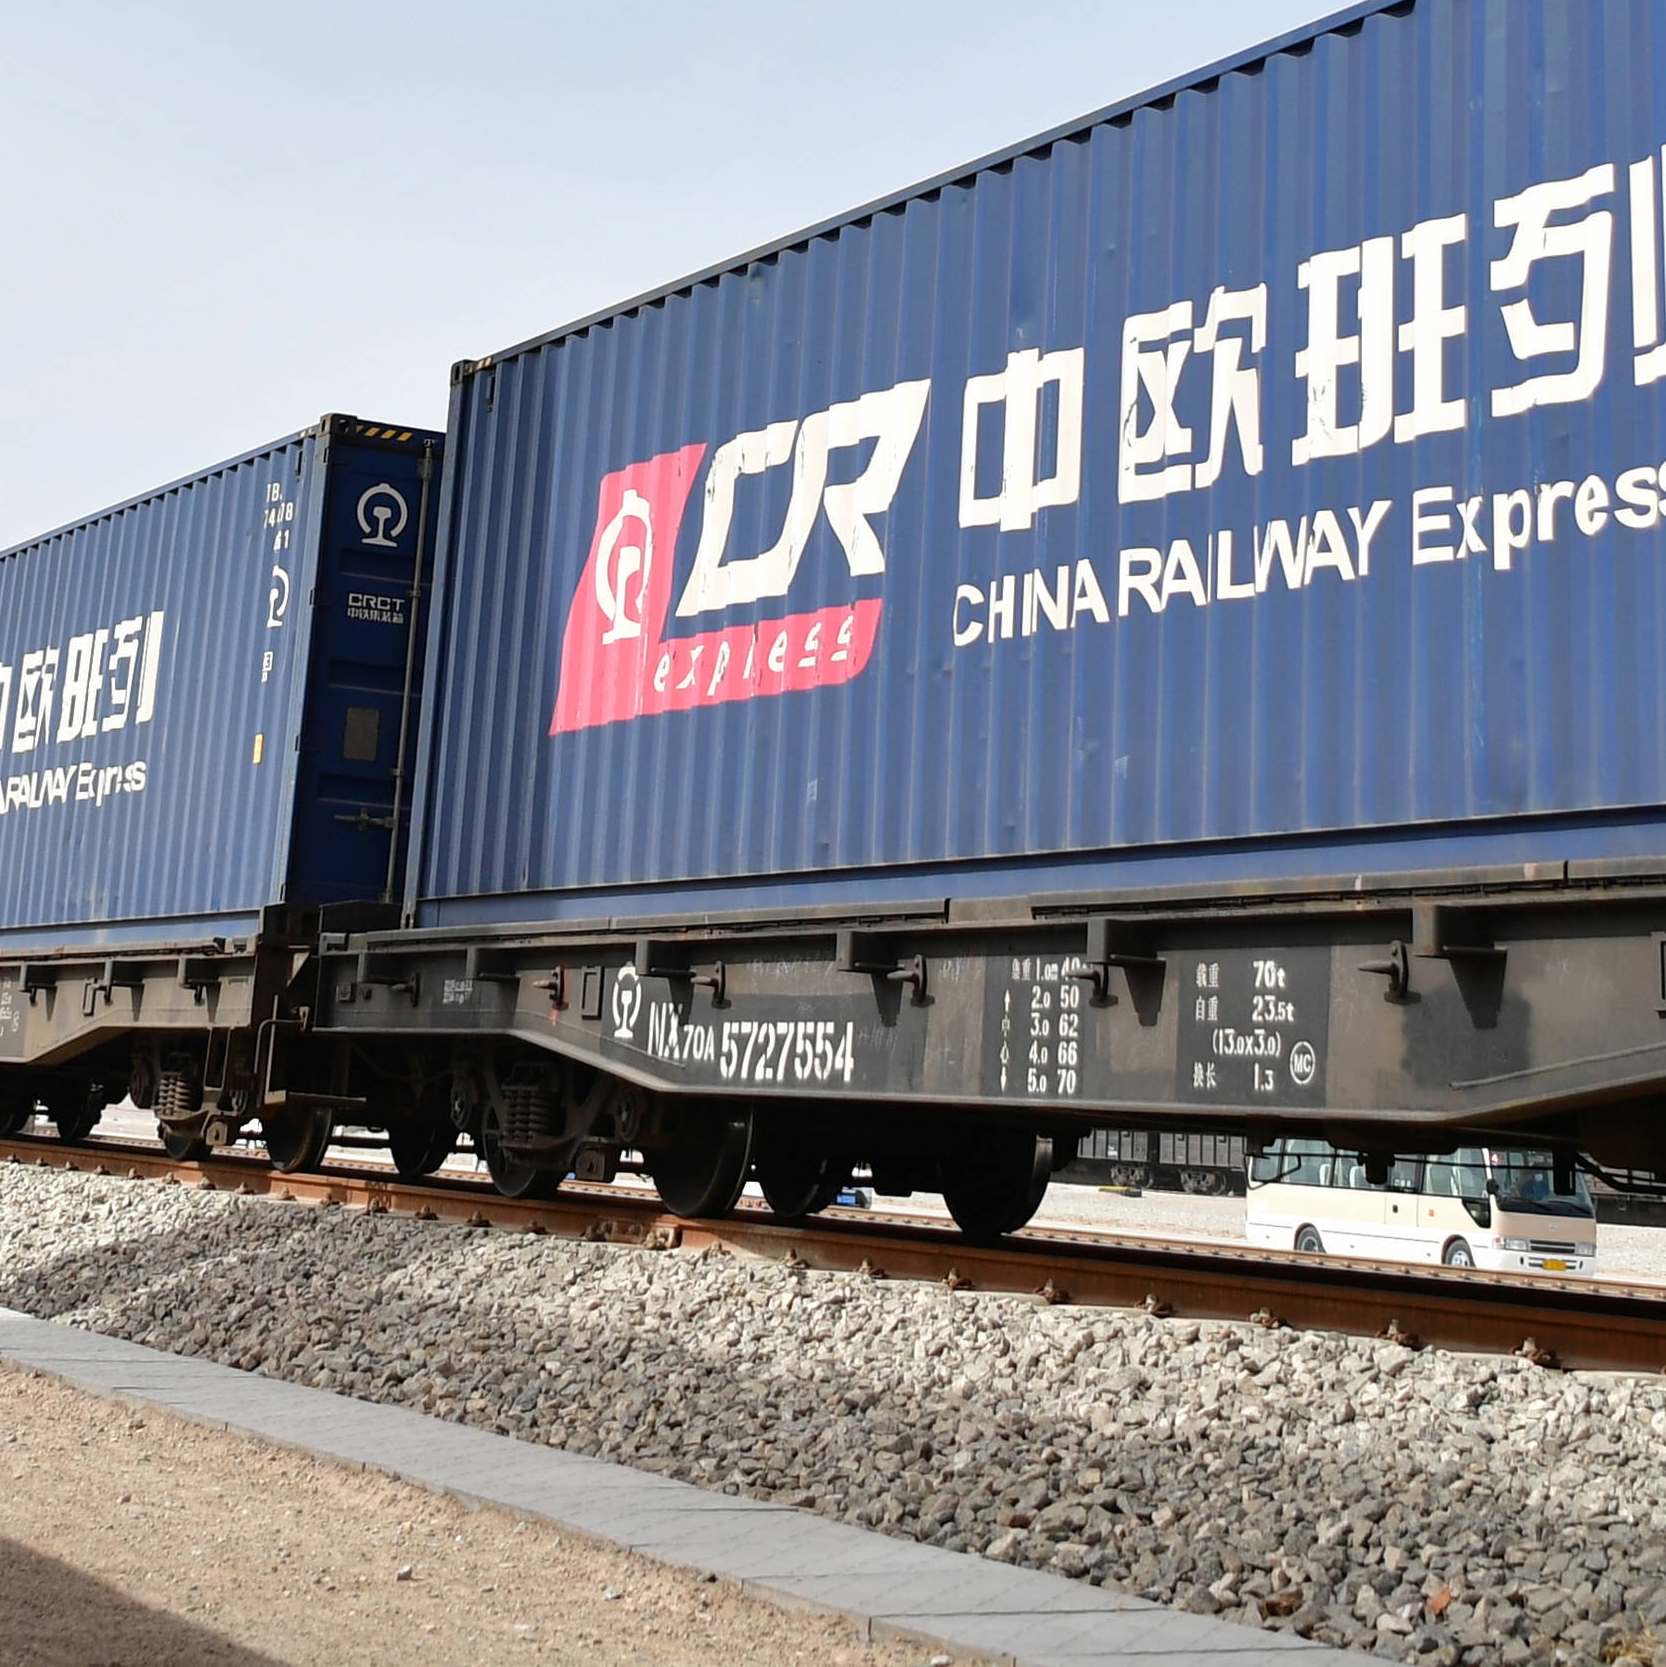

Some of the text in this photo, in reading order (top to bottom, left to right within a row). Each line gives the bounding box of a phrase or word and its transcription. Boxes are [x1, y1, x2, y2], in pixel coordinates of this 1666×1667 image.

[675, 377, 931, 617] CR
[952, 558, 1110, 646] CHINA
[1118, 499, 1393, 617] RAILWAY
[348, 593, 405, 612] CRCT
[1195, 960, 1286, 989] 载重 70t
[1031, 985, 1079, 1009] 2.0 50
[1195, 995, 1219, 1022] 自重
[1030, 1013, 1079, 1038] 3.0 62
[719, 1021, 855, 1082] 5727554
[1029, 1040, 1078, 1065] 4.0 66
[1027, 1069, 1077, 1094] 5.0 70
[1253, 1062, 1274, 1092] 1.3
